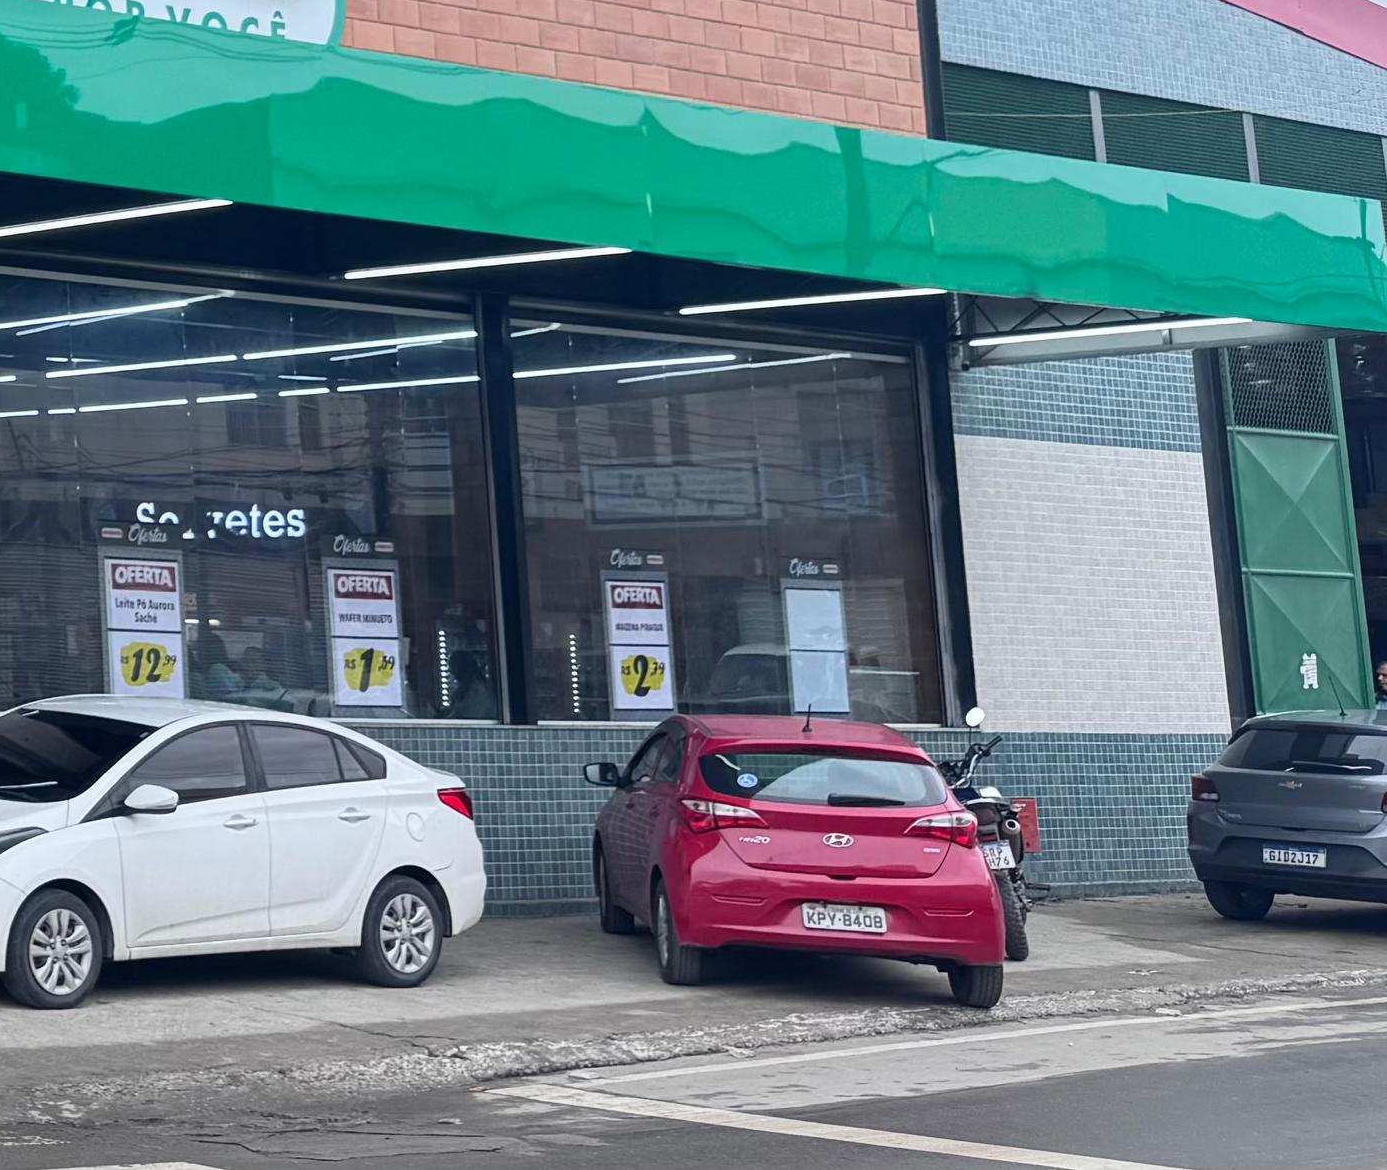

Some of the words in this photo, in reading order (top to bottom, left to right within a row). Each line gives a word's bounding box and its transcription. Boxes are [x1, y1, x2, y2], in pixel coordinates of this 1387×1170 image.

[128, 523, 168, 545] Ofertas
[333, 534, 370, 555] Ofertas
[114, 565, 173, 587] OFERTA
[337, 576, 390, 596] OFERTA
[115, 598, 135, 609] Leite
[148, 600, 175, 610] Aurora
[613, 587, 661, 605] OFERTA
[1269, 850, 1319, 865] GID2J17
